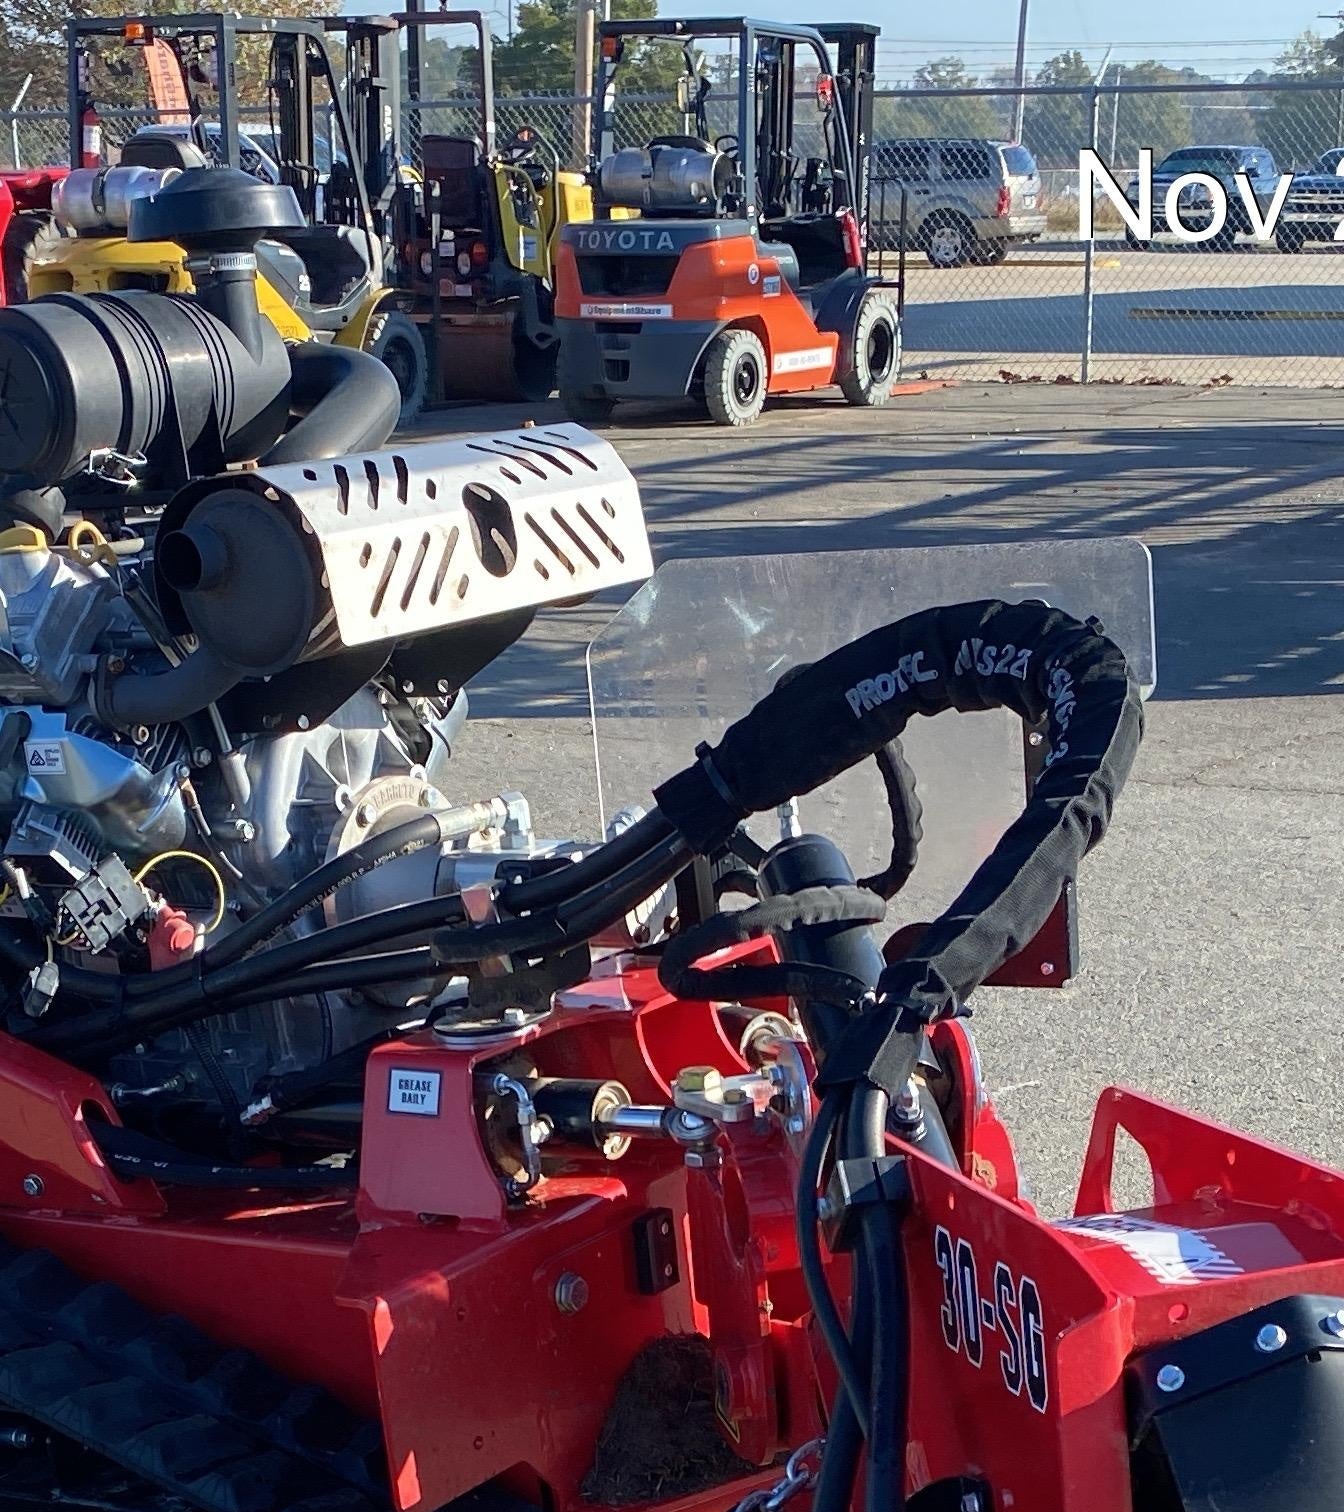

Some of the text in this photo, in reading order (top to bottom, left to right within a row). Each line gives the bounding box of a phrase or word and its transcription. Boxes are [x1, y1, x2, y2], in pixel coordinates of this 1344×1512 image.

[578, 230, 675, 250] TOYOTA
[398, 1078, 432, 1093] GREASE
[401, 1091, 427, 1106] DAILY
[934, 1224, 1049, 1413] 30-SG
